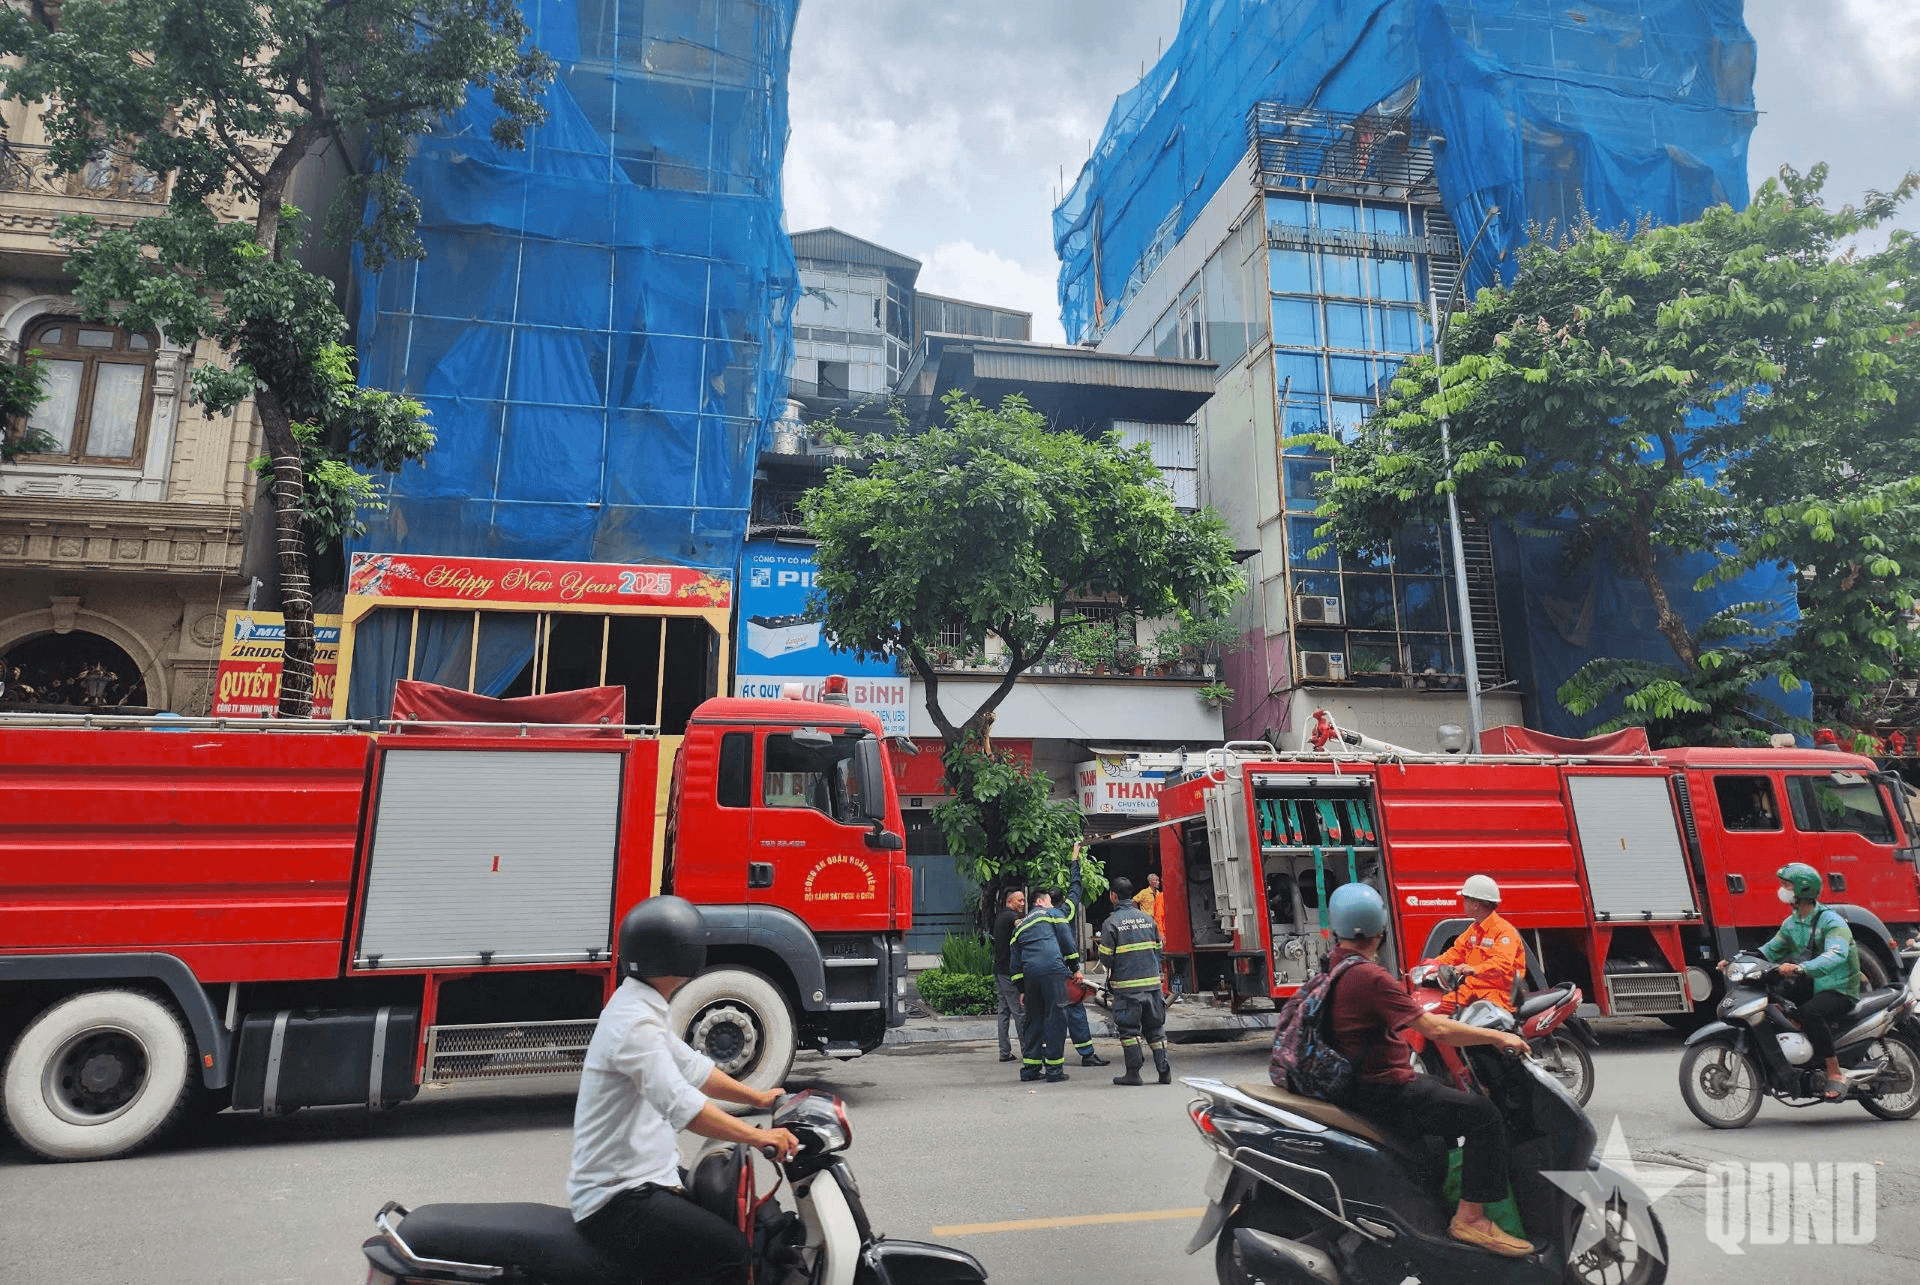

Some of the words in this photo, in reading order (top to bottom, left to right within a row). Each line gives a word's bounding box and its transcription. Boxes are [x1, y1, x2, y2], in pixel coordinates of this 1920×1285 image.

[753, 555, 775, 563] CÔNG
[423, 565, 495, 597] Happy
[501, 567, 553, 591] New
[560, 571, 617, 600] Year
[618, 571, 672, 596] 2025
[255, 627, 337, 639] MICIN
[219, 663, 273, 703] QUYẾT
[855, 682, 904, 705] BÌNH
